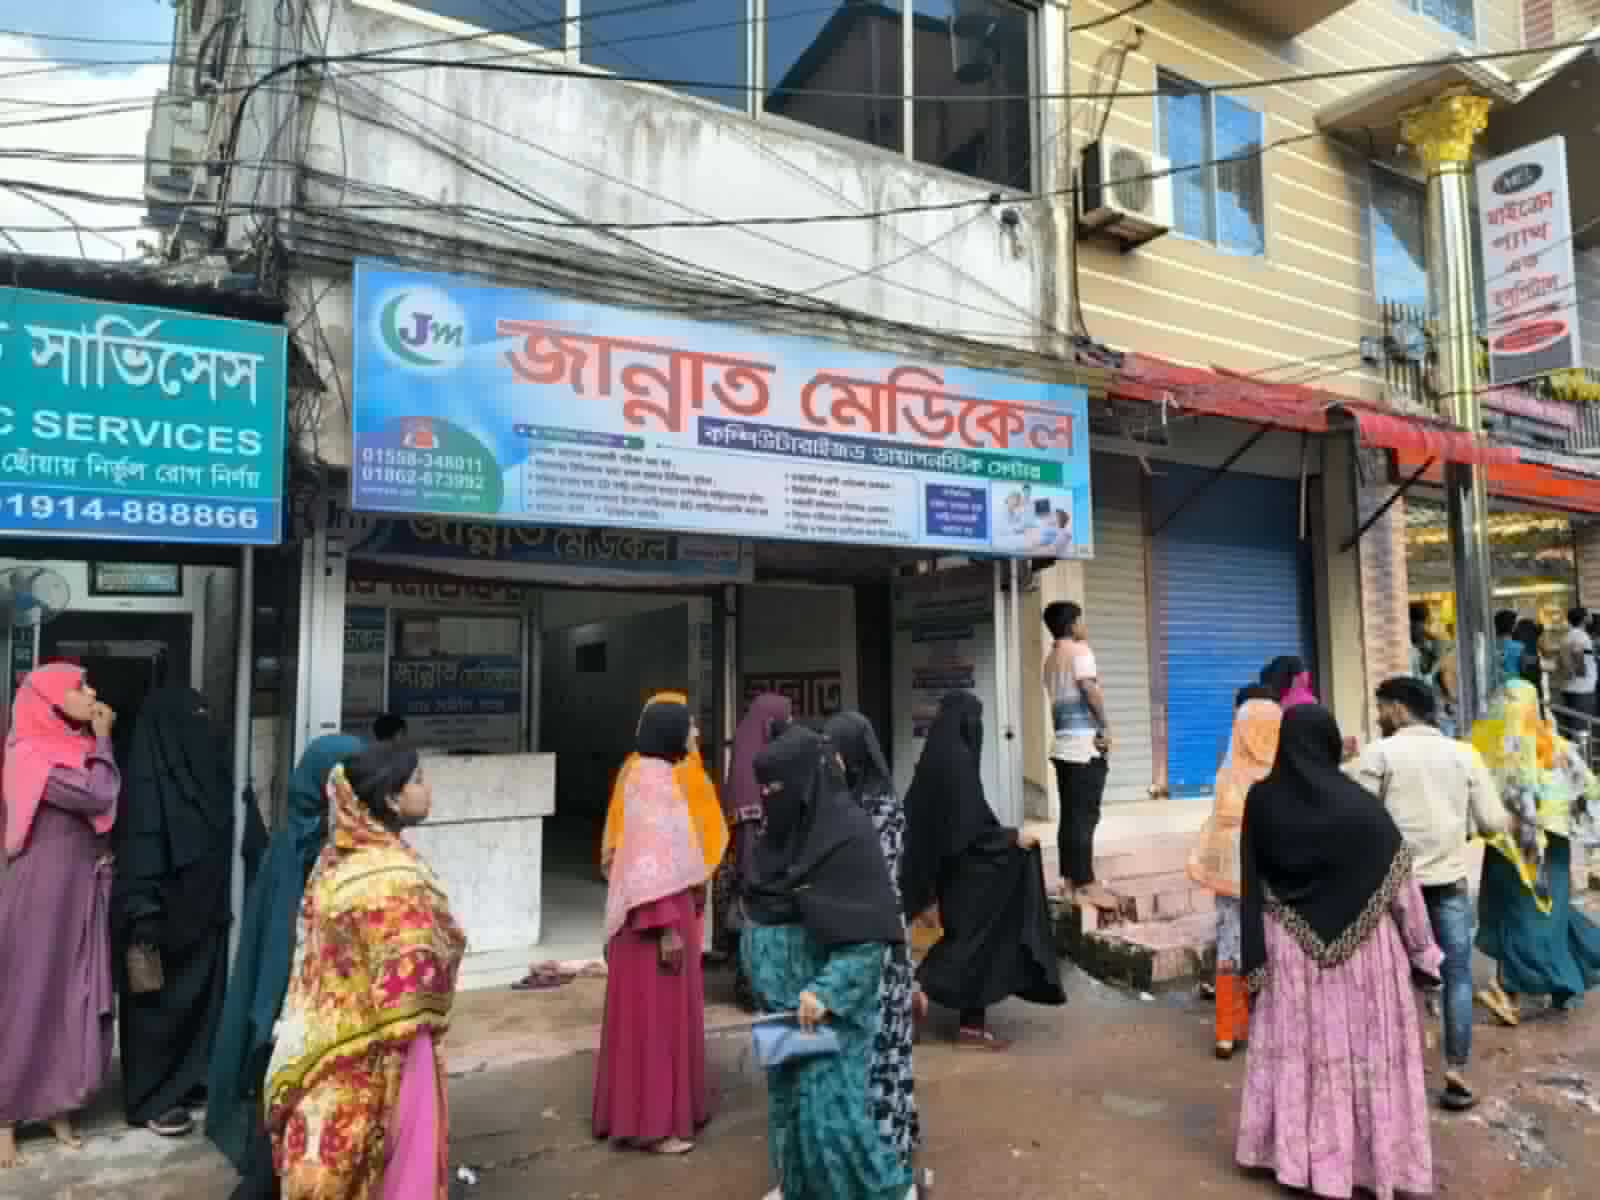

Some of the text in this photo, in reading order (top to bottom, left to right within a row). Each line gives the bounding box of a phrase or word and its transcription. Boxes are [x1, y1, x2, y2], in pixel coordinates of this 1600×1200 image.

[24, 314, 265, 407] সার্ভিসেস
[496, 319, 1074, 456] জান্নাত মেডিকেল
[32, 409, 263, 456] SERVICES
[86, 452, 148, 486] নির্ভুল
[155, 463, 204, 487] রোগ
[0, 492, 260, 529] 1914-888866
